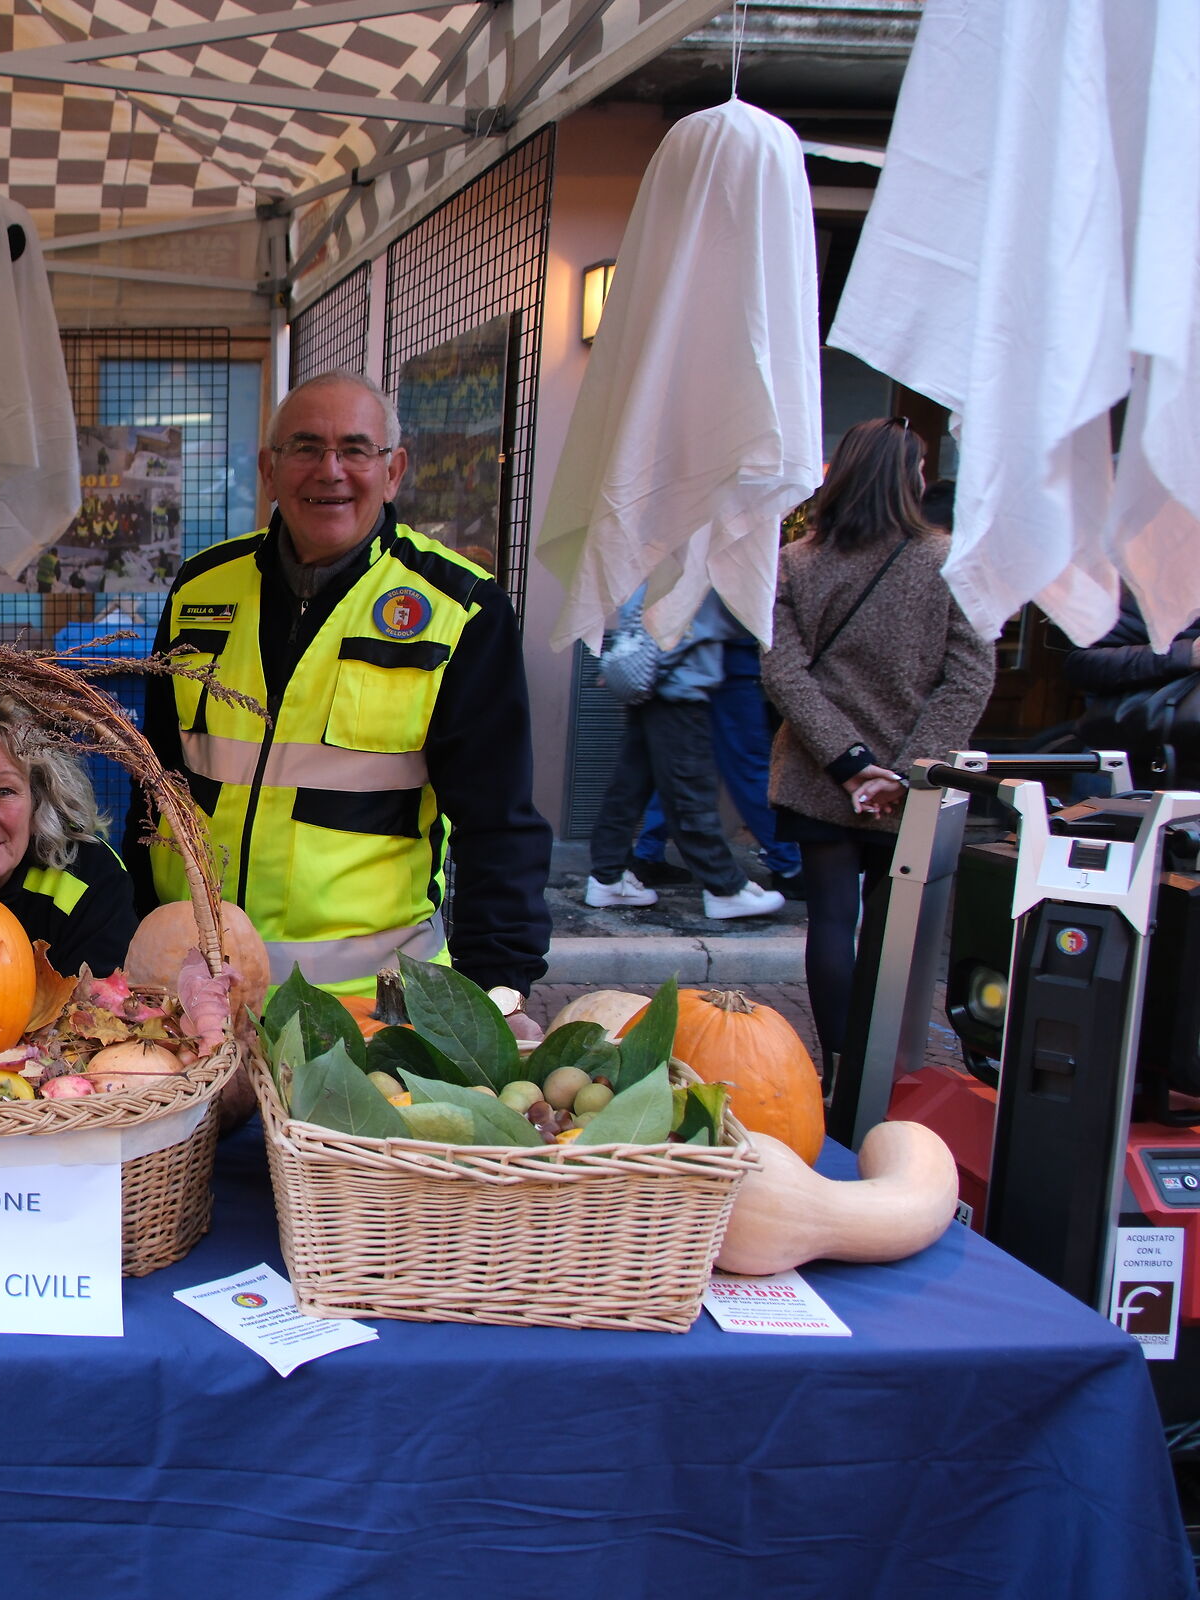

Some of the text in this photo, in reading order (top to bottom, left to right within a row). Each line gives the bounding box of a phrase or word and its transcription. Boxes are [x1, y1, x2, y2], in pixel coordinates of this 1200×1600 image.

[387, 589, 422, 600] VOLONTARI
[386, 628, 414, 636] MELDOLA
[4, 1274, 92, 1298] CIVILE
[711, 1288, 797, 1298] 5X1000
